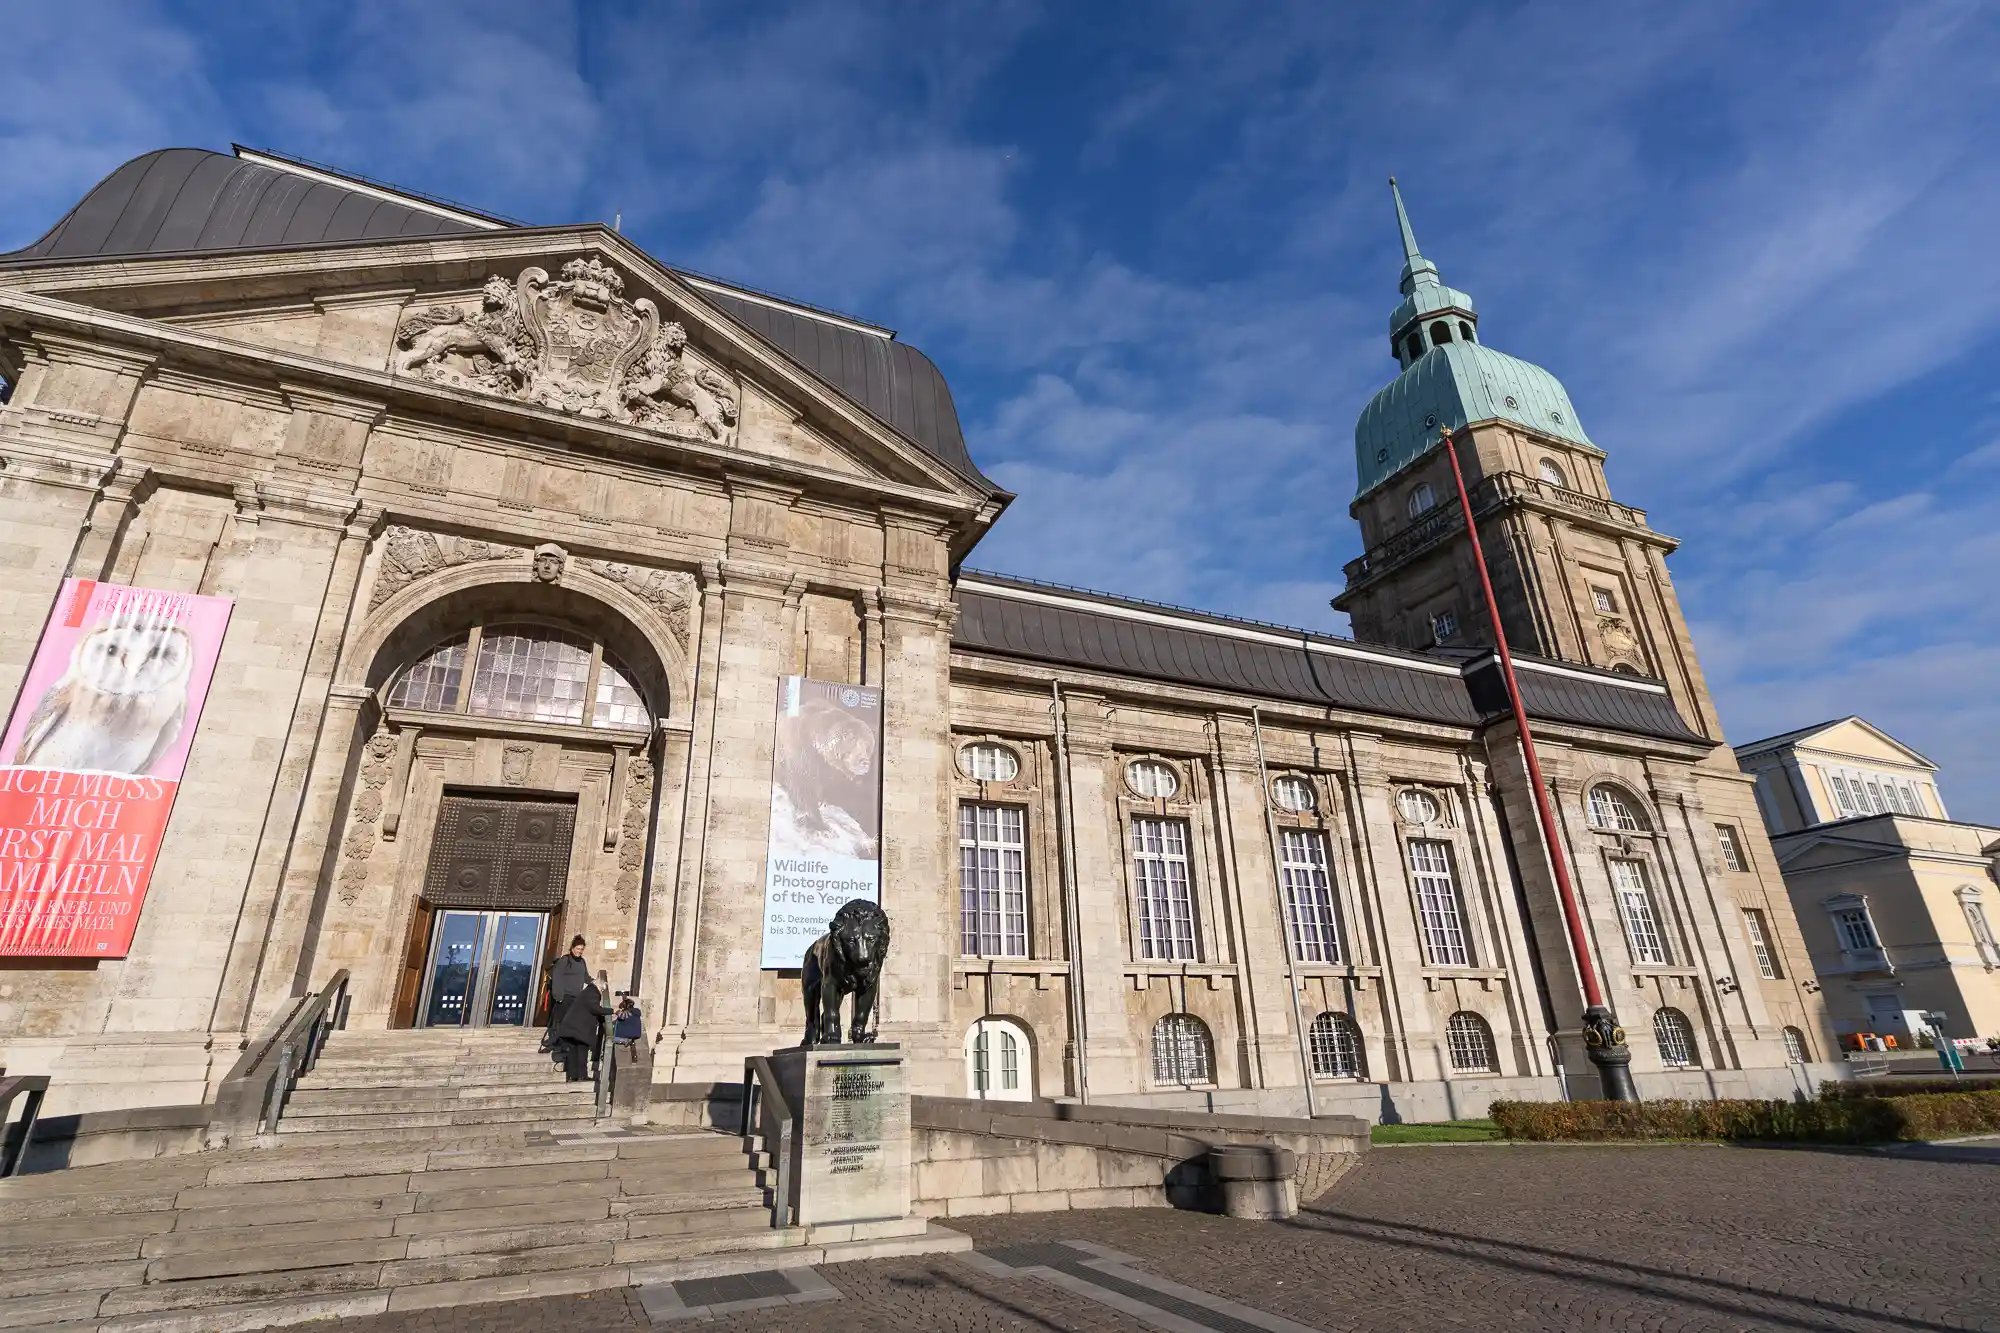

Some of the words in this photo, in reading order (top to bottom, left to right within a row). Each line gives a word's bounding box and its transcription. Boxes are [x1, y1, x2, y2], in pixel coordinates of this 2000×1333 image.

[0, 769, 64, 795] ICH
[71, 773, 163, 800] MUSS
[26, 796, 124, 830] MICH
[0, 828, 72, 859] RST
[72, 831, 147, 862] MAL
[773, 859, 829, 873] Wildlife
[0, 861, 144, 895] MMELN
[772, 875, 873, 892] Photographer
[772, 890, 788, 903] of
[791, 892, 815, 904] the
[818, 892, 851, 905] Year
[46, 900, 95, 915] KNEBL
[99, 901, 131, 916] UND
[78, 916, 114, 930] MATA
[770, 914, 785, 923] 05.
[787, 915, 833, 924] Dezember
[770, 926, 784, 935] bis
[786, 926, 800, 935] 30.
[802, 927, 826, 936] März
[833, 1073, 871, 1083] HESSISCHES
